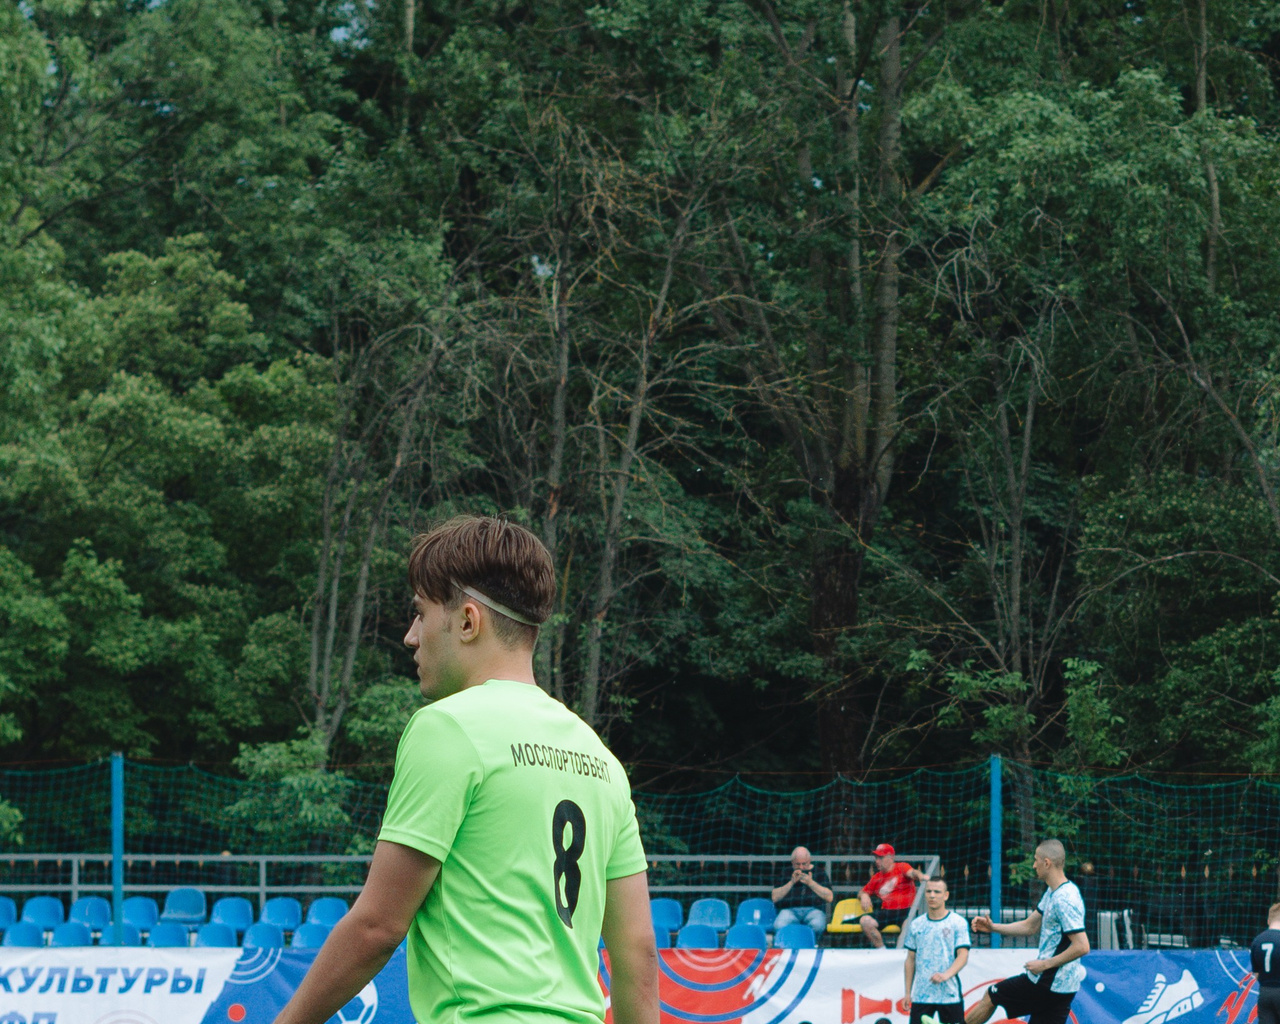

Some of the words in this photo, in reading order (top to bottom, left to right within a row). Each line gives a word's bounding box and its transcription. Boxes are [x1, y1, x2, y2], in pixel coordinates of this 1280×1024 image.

[510, 743, 611, 784] МОССПОРТОБЪЕКТ
[552, 799, 586, 929] 8
[1261, 942, 1274, 973] 7
